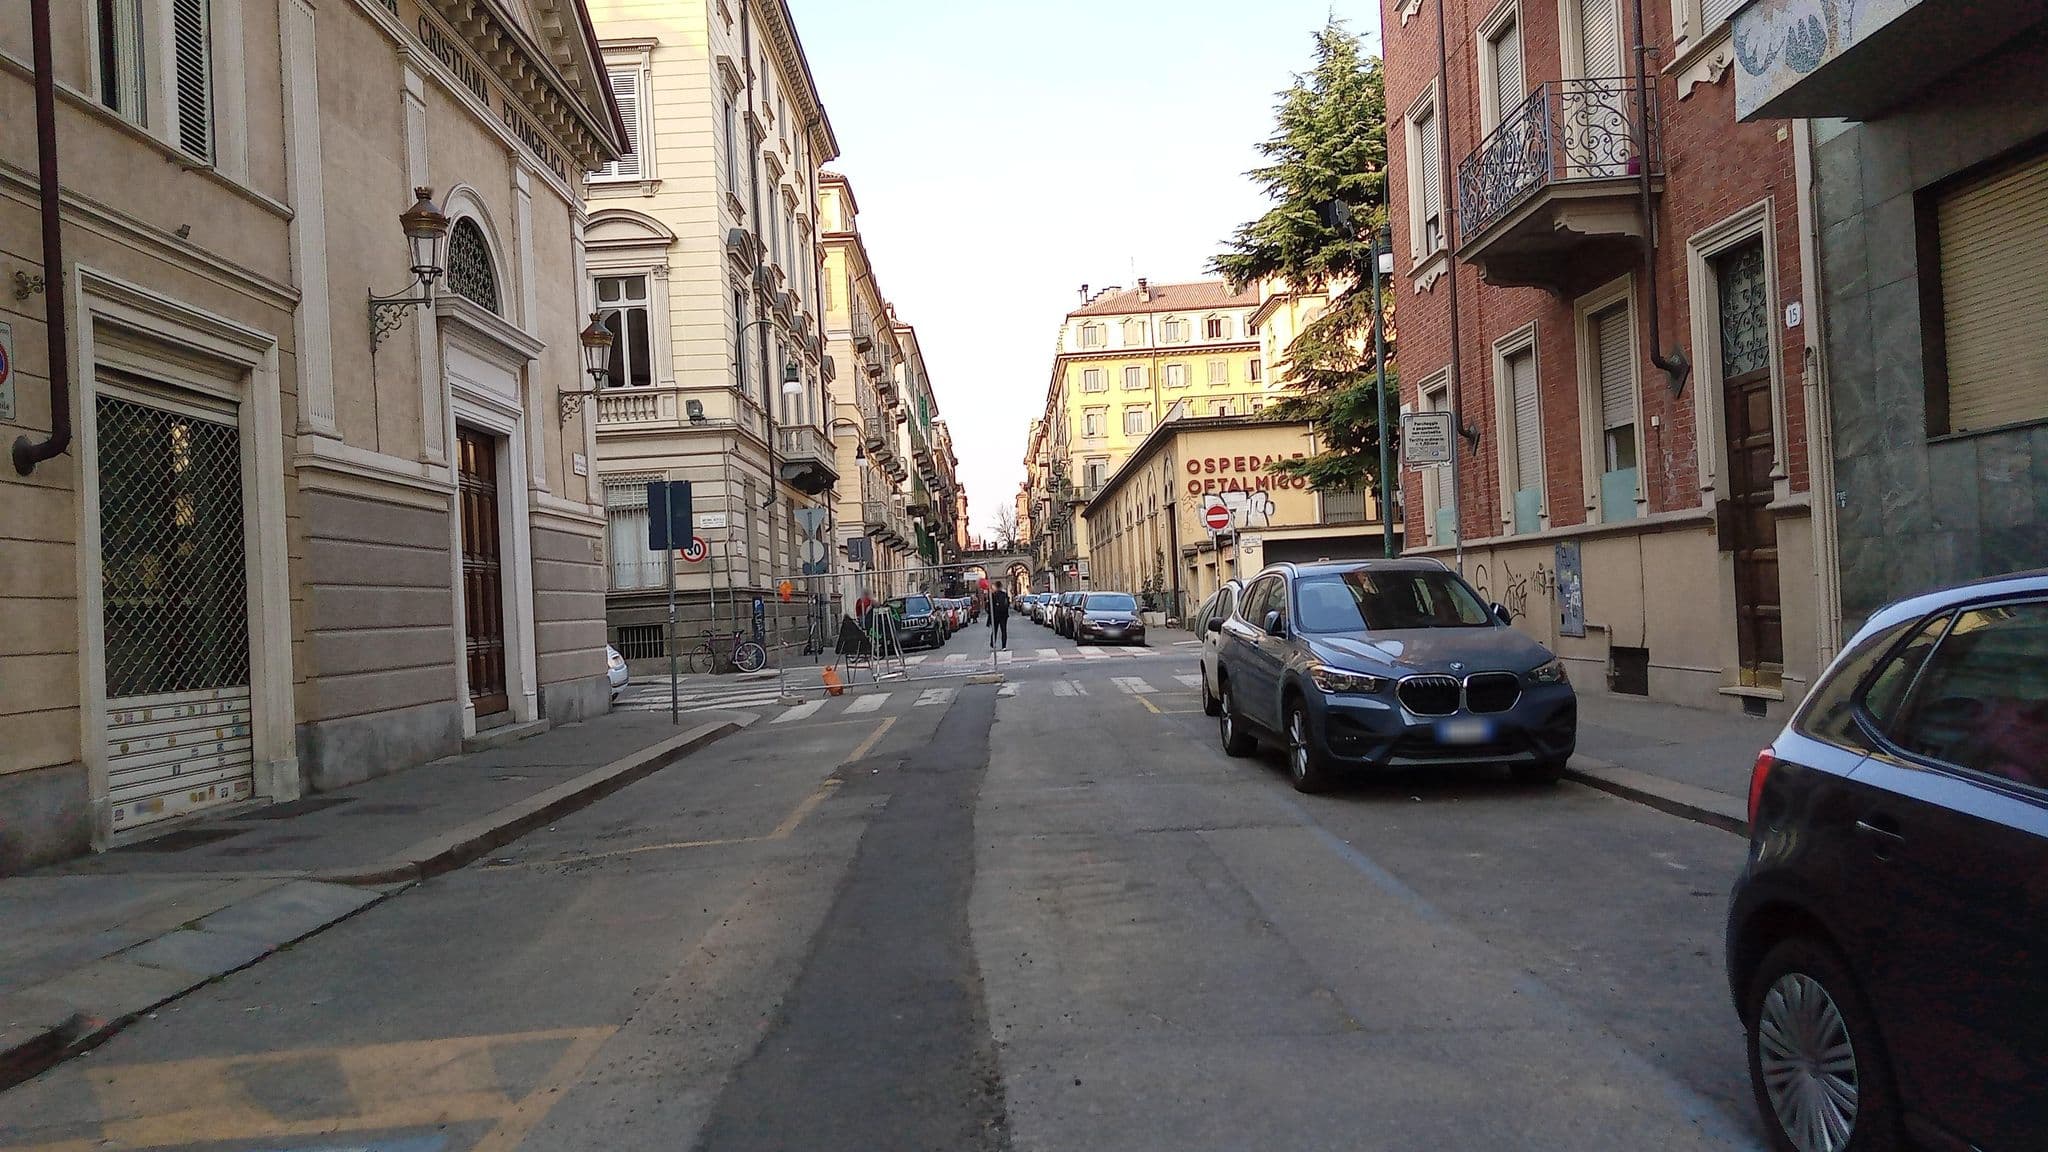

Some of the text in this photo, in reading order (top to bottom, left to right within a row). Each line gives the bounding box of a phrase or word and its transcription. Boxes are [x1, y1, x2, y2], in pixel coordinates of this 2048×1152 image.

[417, 15, 567, 184] CRISTIANA EVANGELICA
[1789, 308, 1798, 324] 15
[1186, 453, 1304, 475] OSPEDA
[1187, 475, 1306, 495] OFTALMICO
[687, 543, 701, 556] 30
